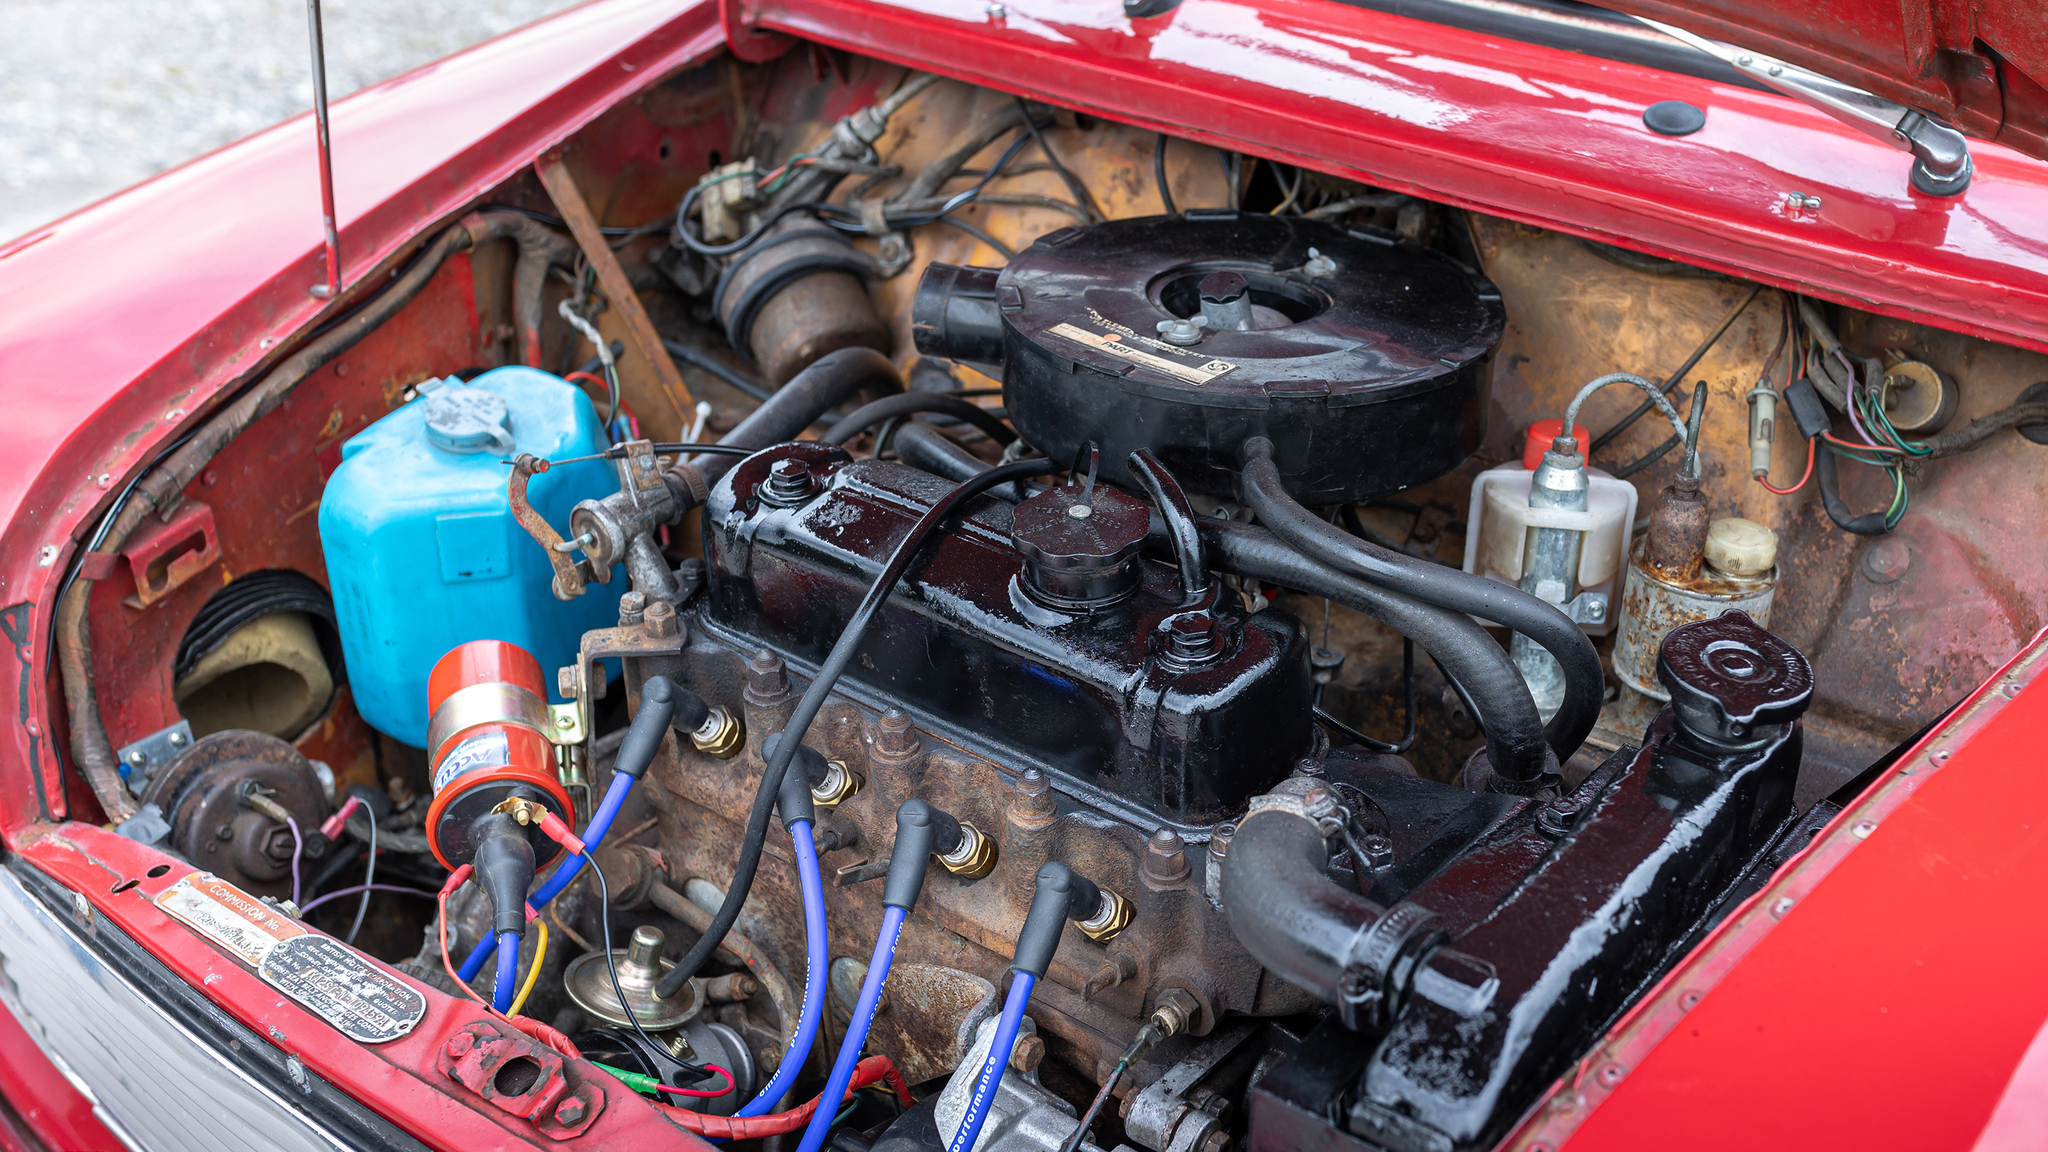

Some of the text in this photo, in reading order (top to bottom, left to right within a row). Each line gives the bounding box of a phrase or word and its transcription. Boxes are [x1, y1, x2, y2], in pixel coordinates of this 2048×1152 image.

[1081, 334, 1134, 354] UNIPART
[209, 884, 280, 932] COMMISSION No.
[320, 943, 346, 959] BRITISH
[343, 956, 369, 974] MOTOR
[280, 978, 298, 992] WITH
[287, 973, 304, 985] SEAT
[301, 981, 318, 994] BELT
[356, 1018, 384, 1039] COMPLY
[952, 1056, 997, 1152] performance
